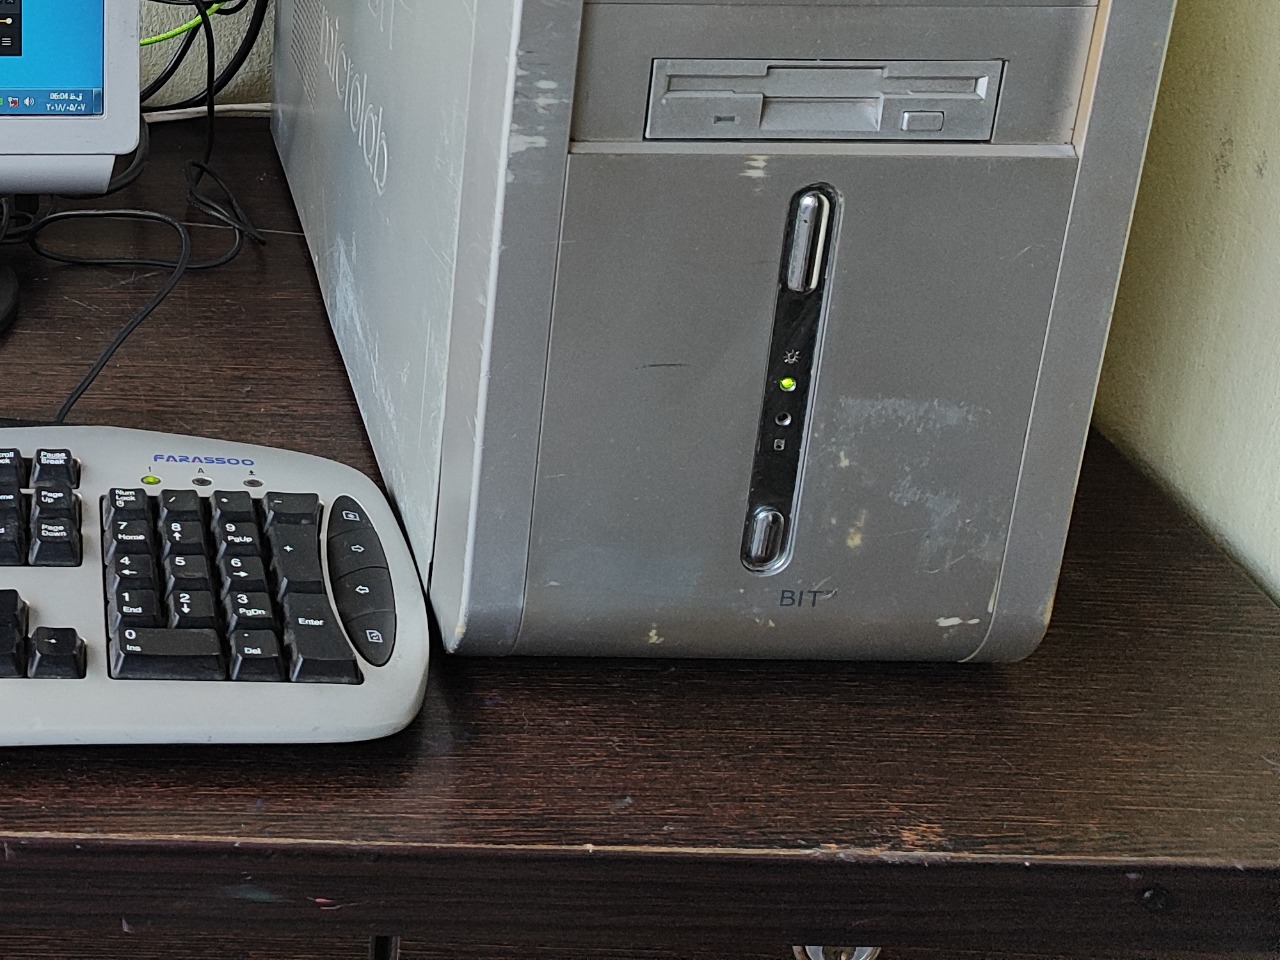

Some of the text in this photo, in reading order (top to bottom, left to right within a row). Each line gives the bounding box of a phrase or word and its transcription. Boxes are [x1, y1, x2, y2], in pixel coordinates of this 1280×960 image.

[153, 454, 255, 466] FARASSOO
[41, 491, 64, 499] Page
[117, 521, 128, 530] 7
[170, 523, 182, 531] 8
[225, 523, 236, 532] 9
[227, 535, 253, 543] PgUp
[119, 556, 131, 565] 4
[174, 556, 186, 566] 5
[230, 558, 242, 567] 6
[122, 592, 130, 602] 1
[179, 593, 190, 603] 2
[236, 594, 248, 604] 3
[238, 608, 266, 616] PgDn
[297, 617, 324, 626] Enter
[124, 629, 136, 639] 0
[126, 644, 141, 652] Ins
[243, 646, 262, 655] Del
